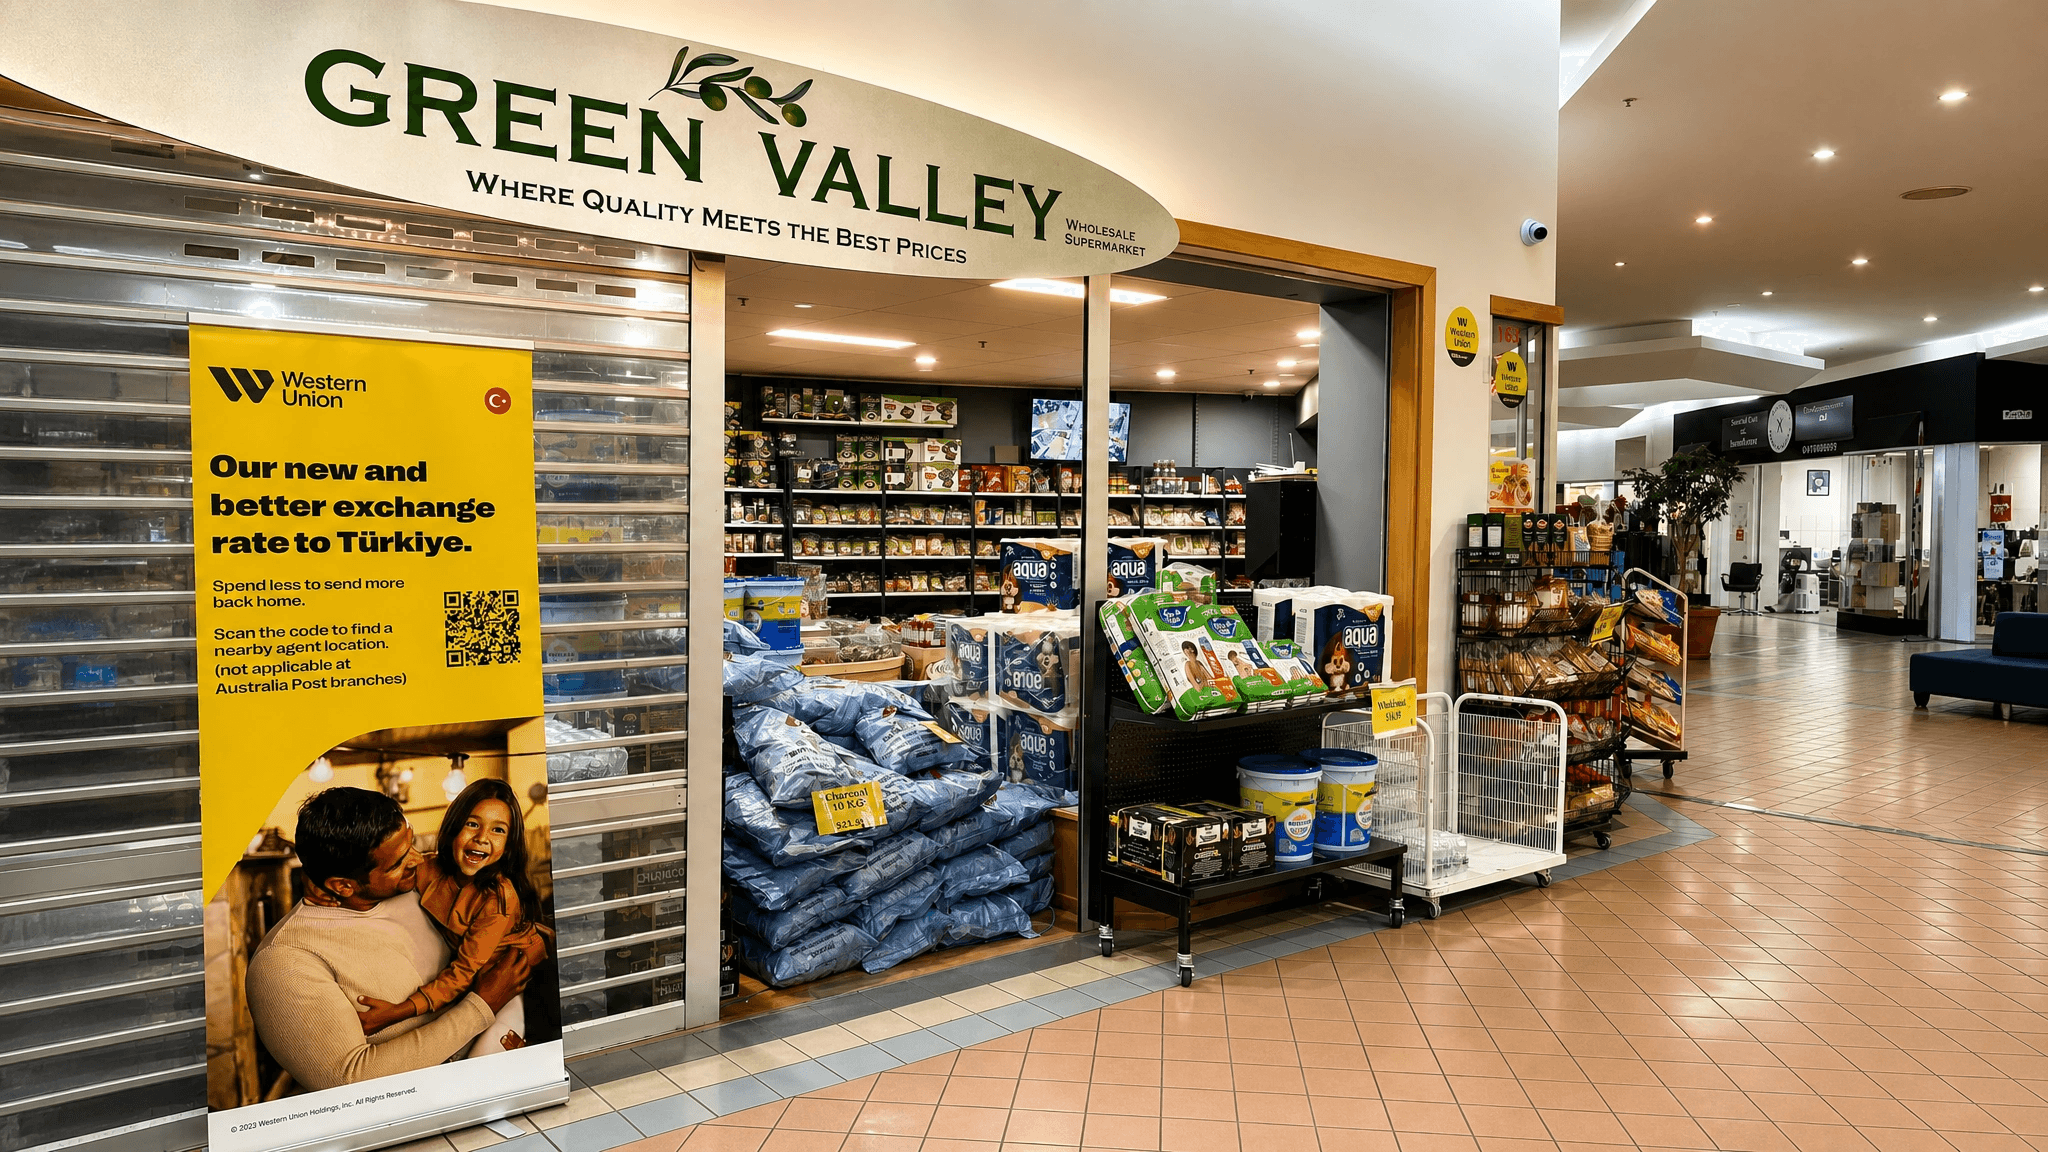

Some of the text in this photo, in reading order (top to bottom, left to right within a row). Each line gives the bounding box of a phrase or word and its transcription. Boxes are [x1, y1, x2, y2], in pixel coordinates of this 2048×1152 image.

[305, 49, 1062, 241] GREEN VALLEY
[1065, 218, 1136, 242] WHOLESALE
[1065, 233, 1146, 257] SUPERMARKET
[281, 370, 367, 392] Western
[282, 389, 343, 408] Union
[210, 455, 426, 482] Our new and
[211, 494, 495, 523] better exchange
[212, 531, 472, 557] rate to Türkiye.
[1013, 562, 1047, 579] aqua
[1112, 561, 1146, 579] aqua
[213, 578, 404, 594] Spend less to send more
[214, 596, 305, 608] back home.
[214, 623, 392, 640] Scan the code to find a
[1345, 626, 1378, 649] aqua
[215, 639, 388, 656] nearby agent location.
[216, 659, 351, 678] (not applicable at
[216, 673, 406, 694] Australia Post branches)
[1020, 733, 1047, 755] aqua
[825, 788, 869, 801] Charcoal
[833, 801, 845, 811] 10
[239, 1121, 257, 1132] 2023
[258, 1116, 288, 1126] Western
[288, 1111, 309, 1121] Union
[310, 1104, 342, 1116] Holdings,
[342, 1100, 355, 1108] Inc.
[355, 1097, 364, 1105] All
[365, 1093, 385, 1104] Rights
[385, 1087, 418, 1099] Reserved.
